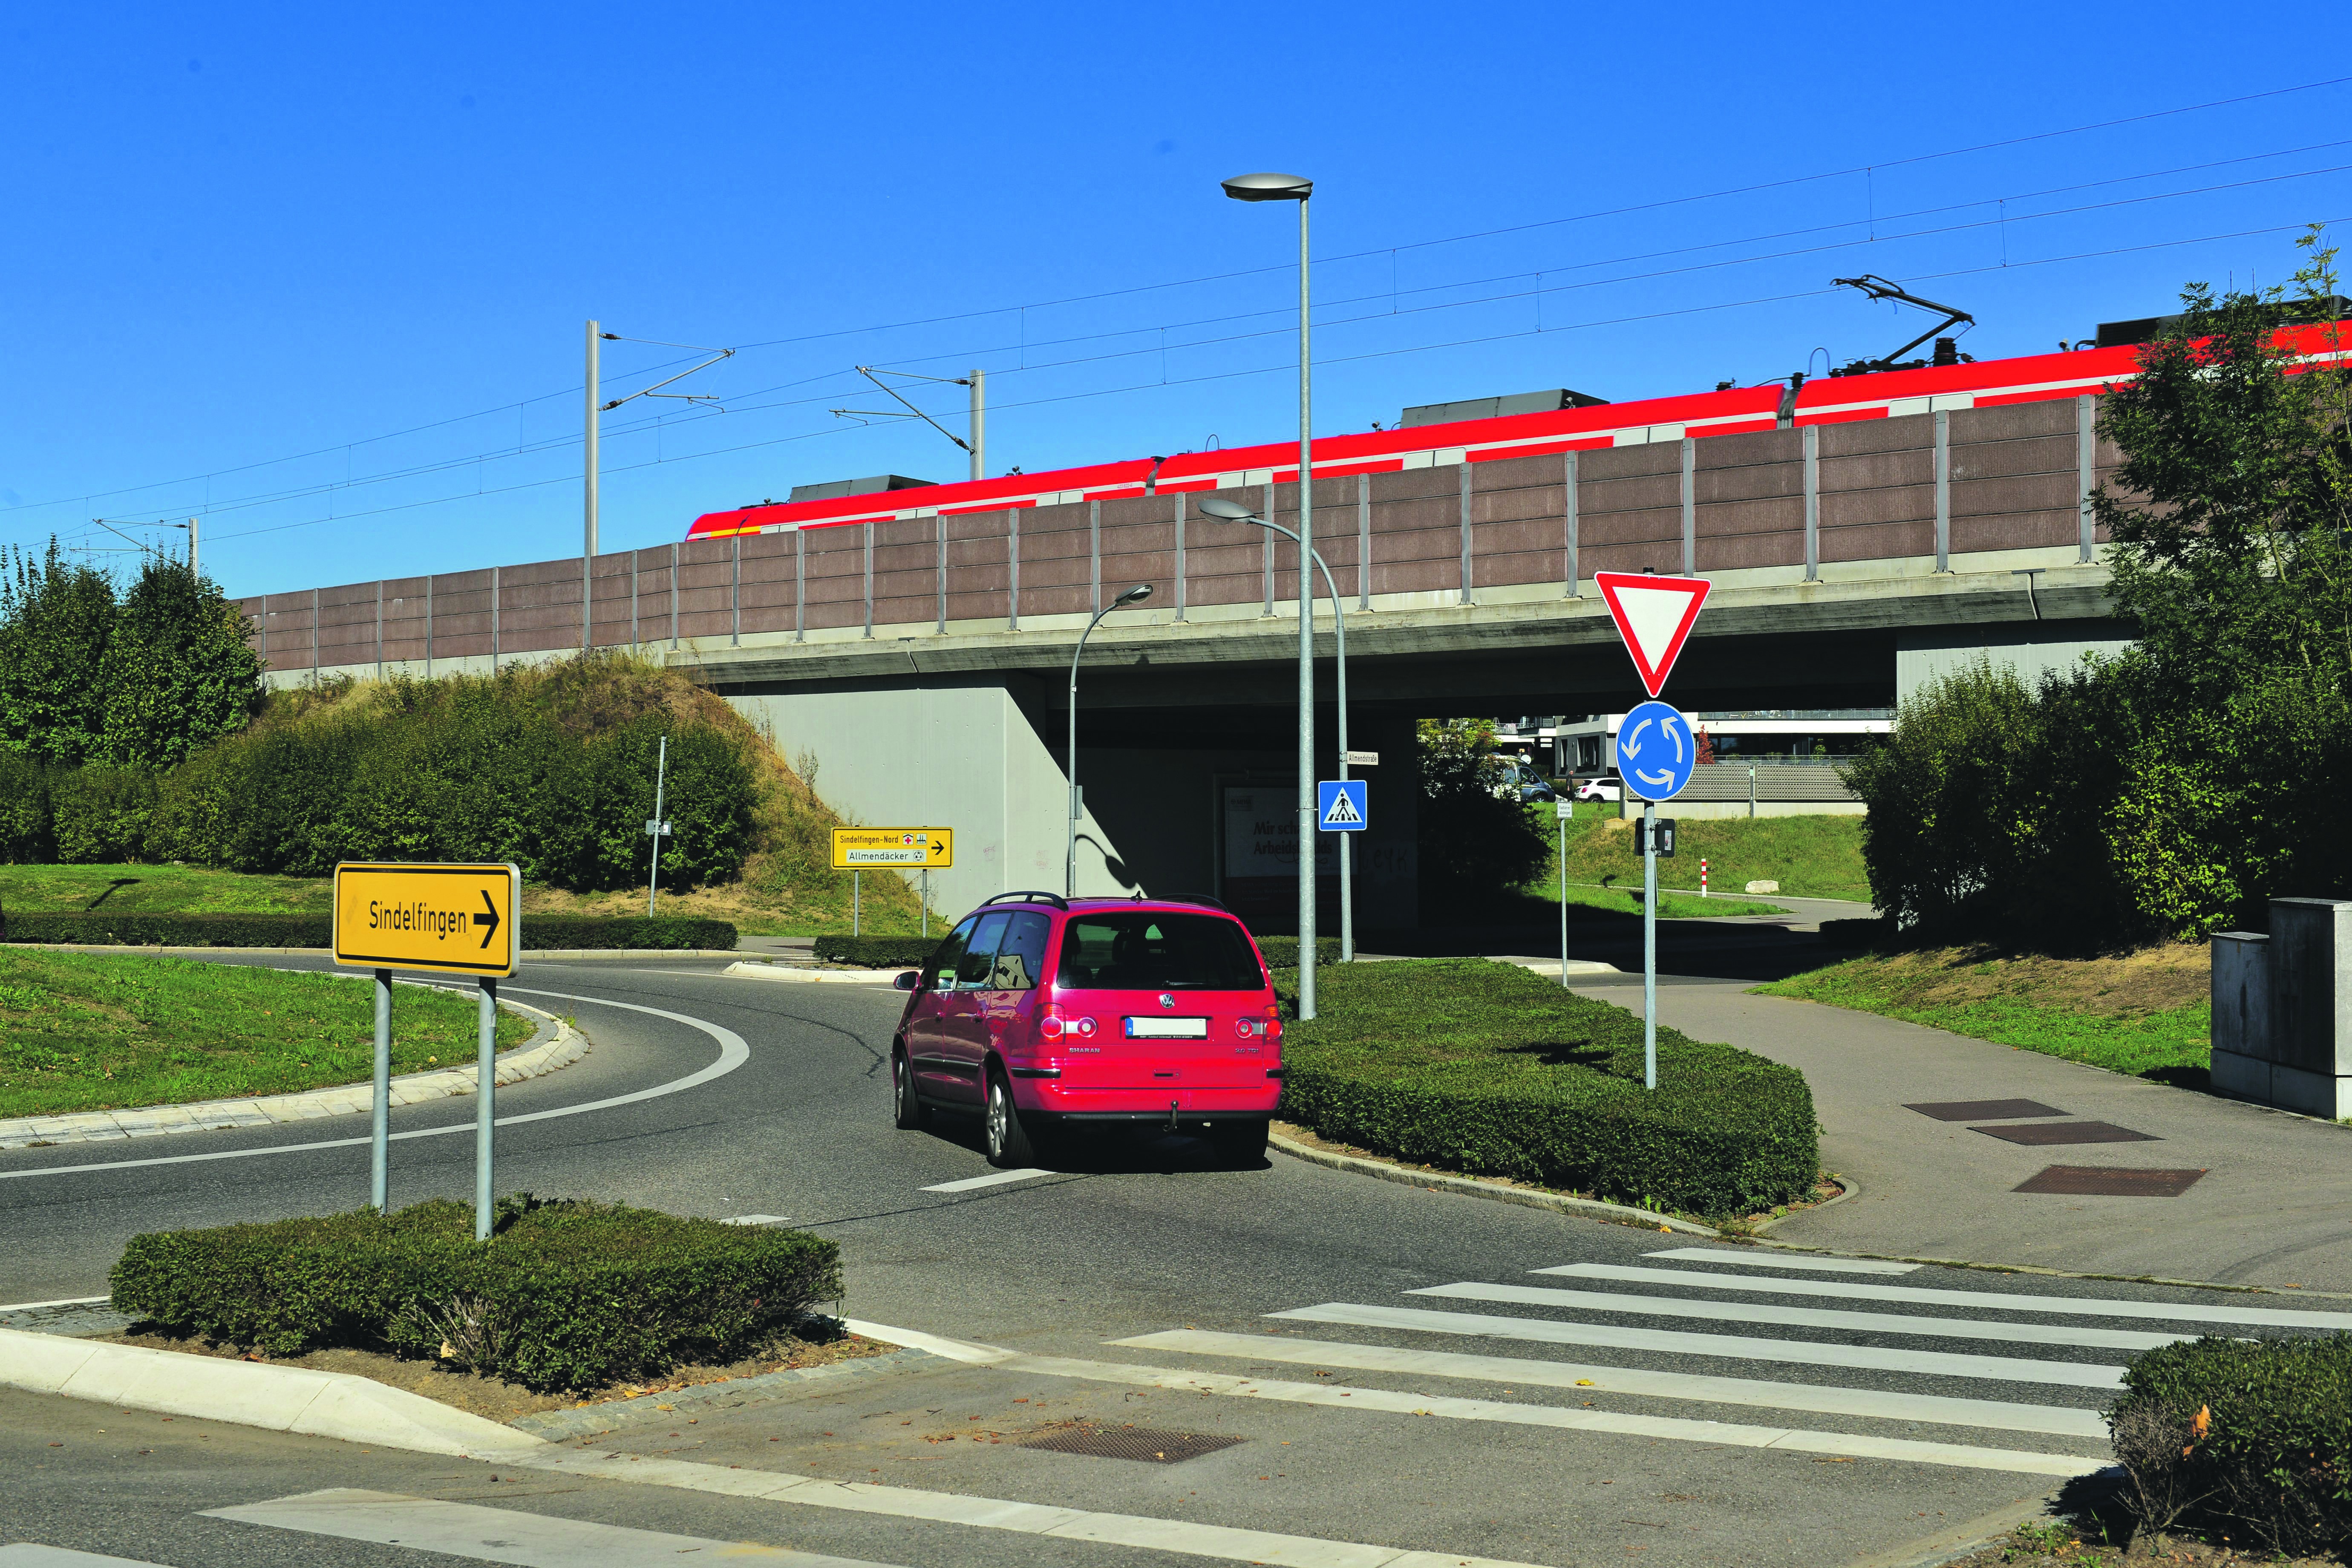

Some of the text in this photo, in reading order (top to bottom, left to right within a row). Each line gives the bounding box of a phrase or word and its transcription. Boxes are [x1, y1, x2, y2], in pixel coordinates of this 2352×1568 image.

[1349, 754, 1377, 762] Allmendstraße
[1254, 821, 1275, 835] Mir
[840, 835, 898, 845] Sindelfingen-Nord
[369, 900, 466, 940] Sindelfingen
